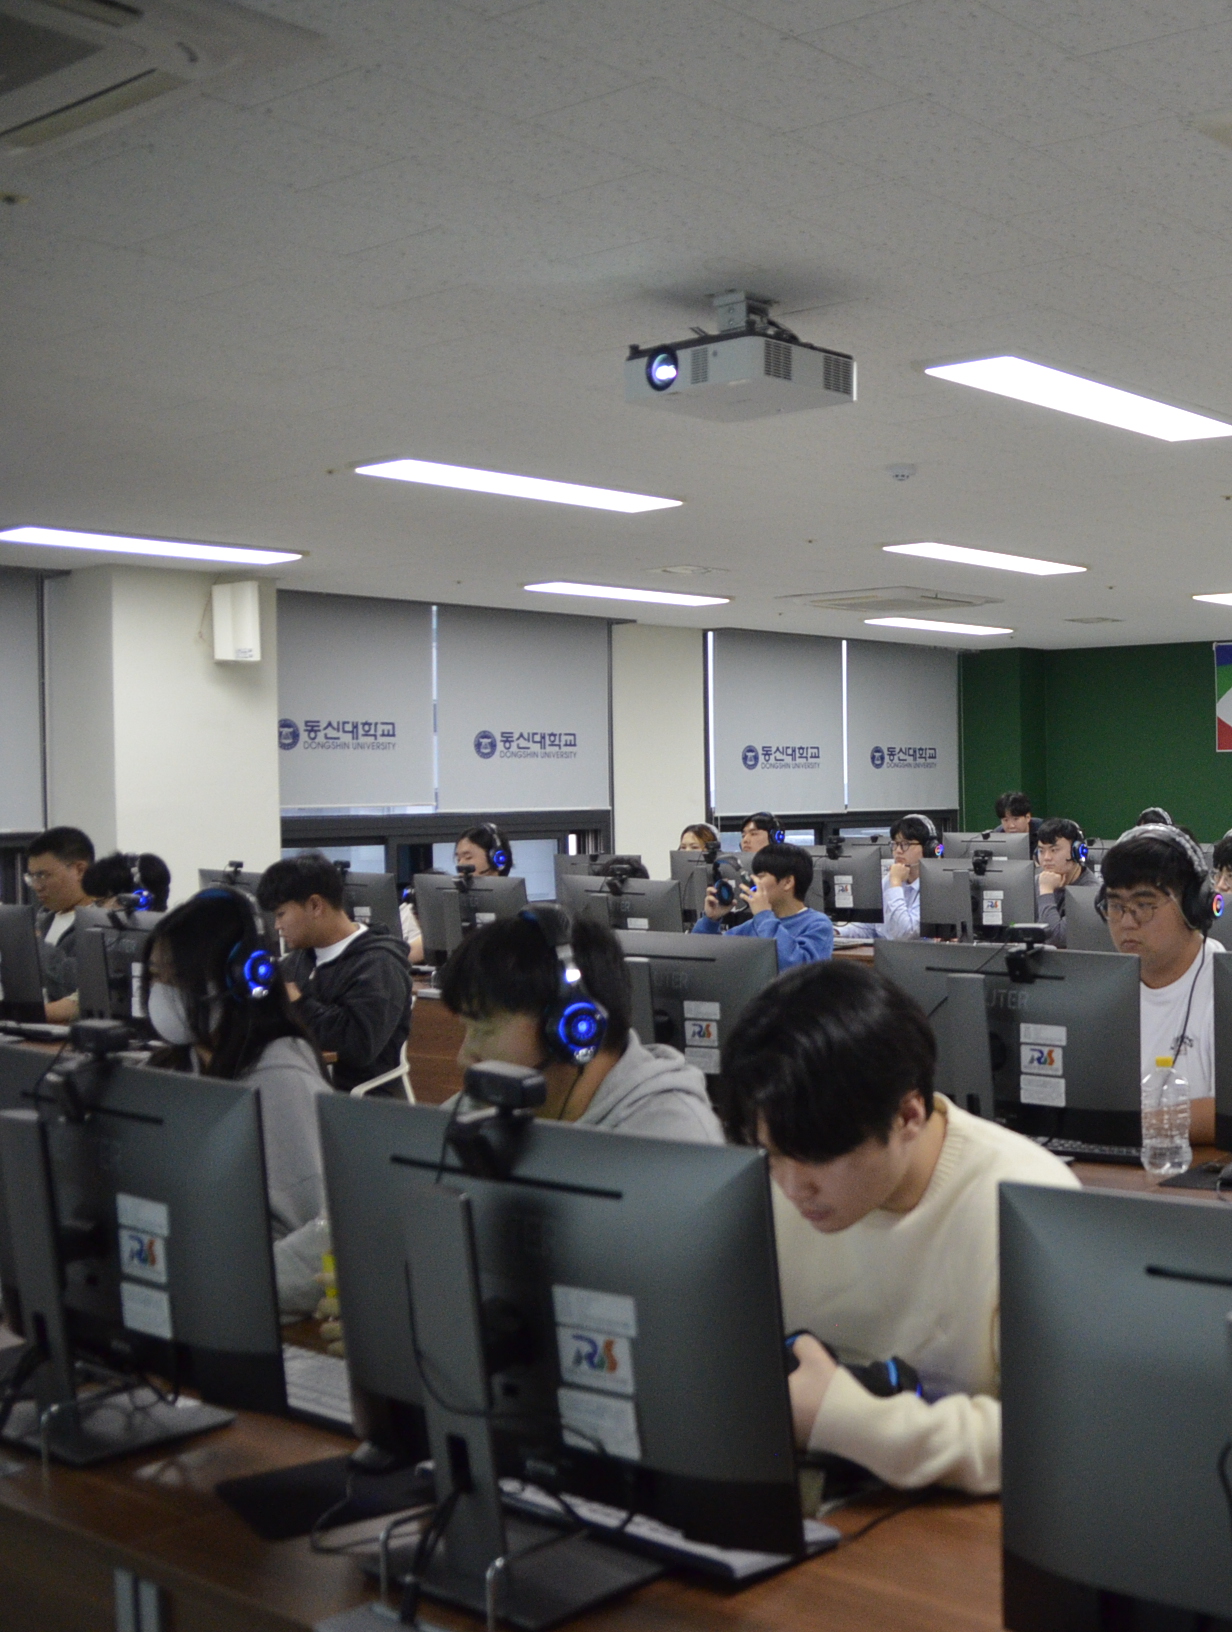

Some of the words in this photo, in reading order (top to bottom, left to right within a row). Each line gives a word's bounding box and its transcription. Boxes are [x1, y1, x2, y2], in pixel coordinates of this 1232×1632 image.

[303, 719, 396, 741] 동신대학교
[303, 740, 350, 751] DONGSHIN
[351, 741, 396, 751] UNIVERSITY
[500, 730, 577, 751] 동신대학교
[500, 750, 539, 759] DONGSHIN
[540, 751, 577, 759] UNIVERSITY
[760, 745, 821, 762] 동신대학교
[886, 746, 938, 762] 동신대학교
